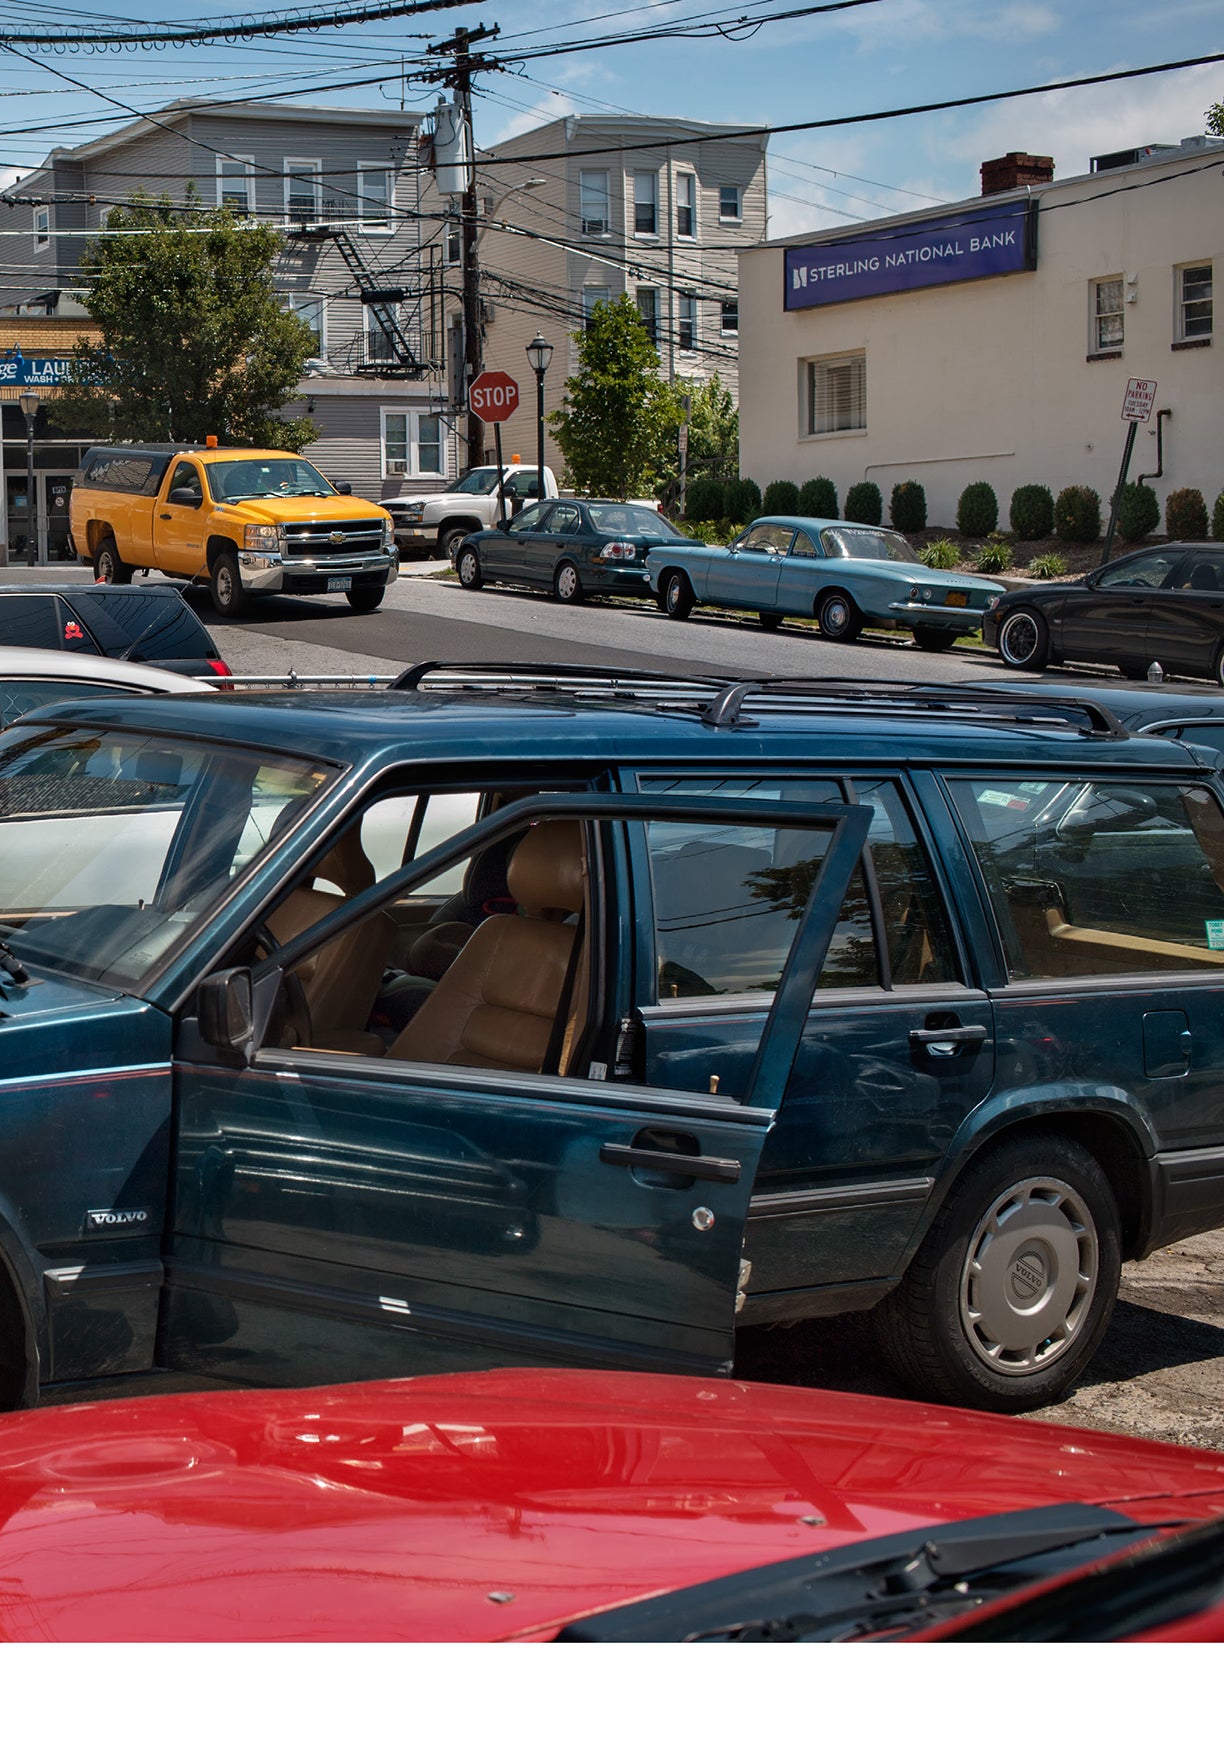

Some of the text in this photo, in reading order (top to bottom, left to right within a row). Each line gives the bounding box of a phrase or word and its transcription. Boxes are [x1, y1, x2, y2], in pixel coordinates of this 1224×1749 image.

[810, 230, 1016, 283] STERLING NATIONAL BANK
[23, 375, 53, 383] WASH
[1136, 382, 1148, 390] NO
[473, 385, 516, 408] STOP
[1128, 390, 1153, 401] PARKING
[91, 1210, 148, 1225] VOLVO
[1016, 1263, 1042, 1287] VOLVO
